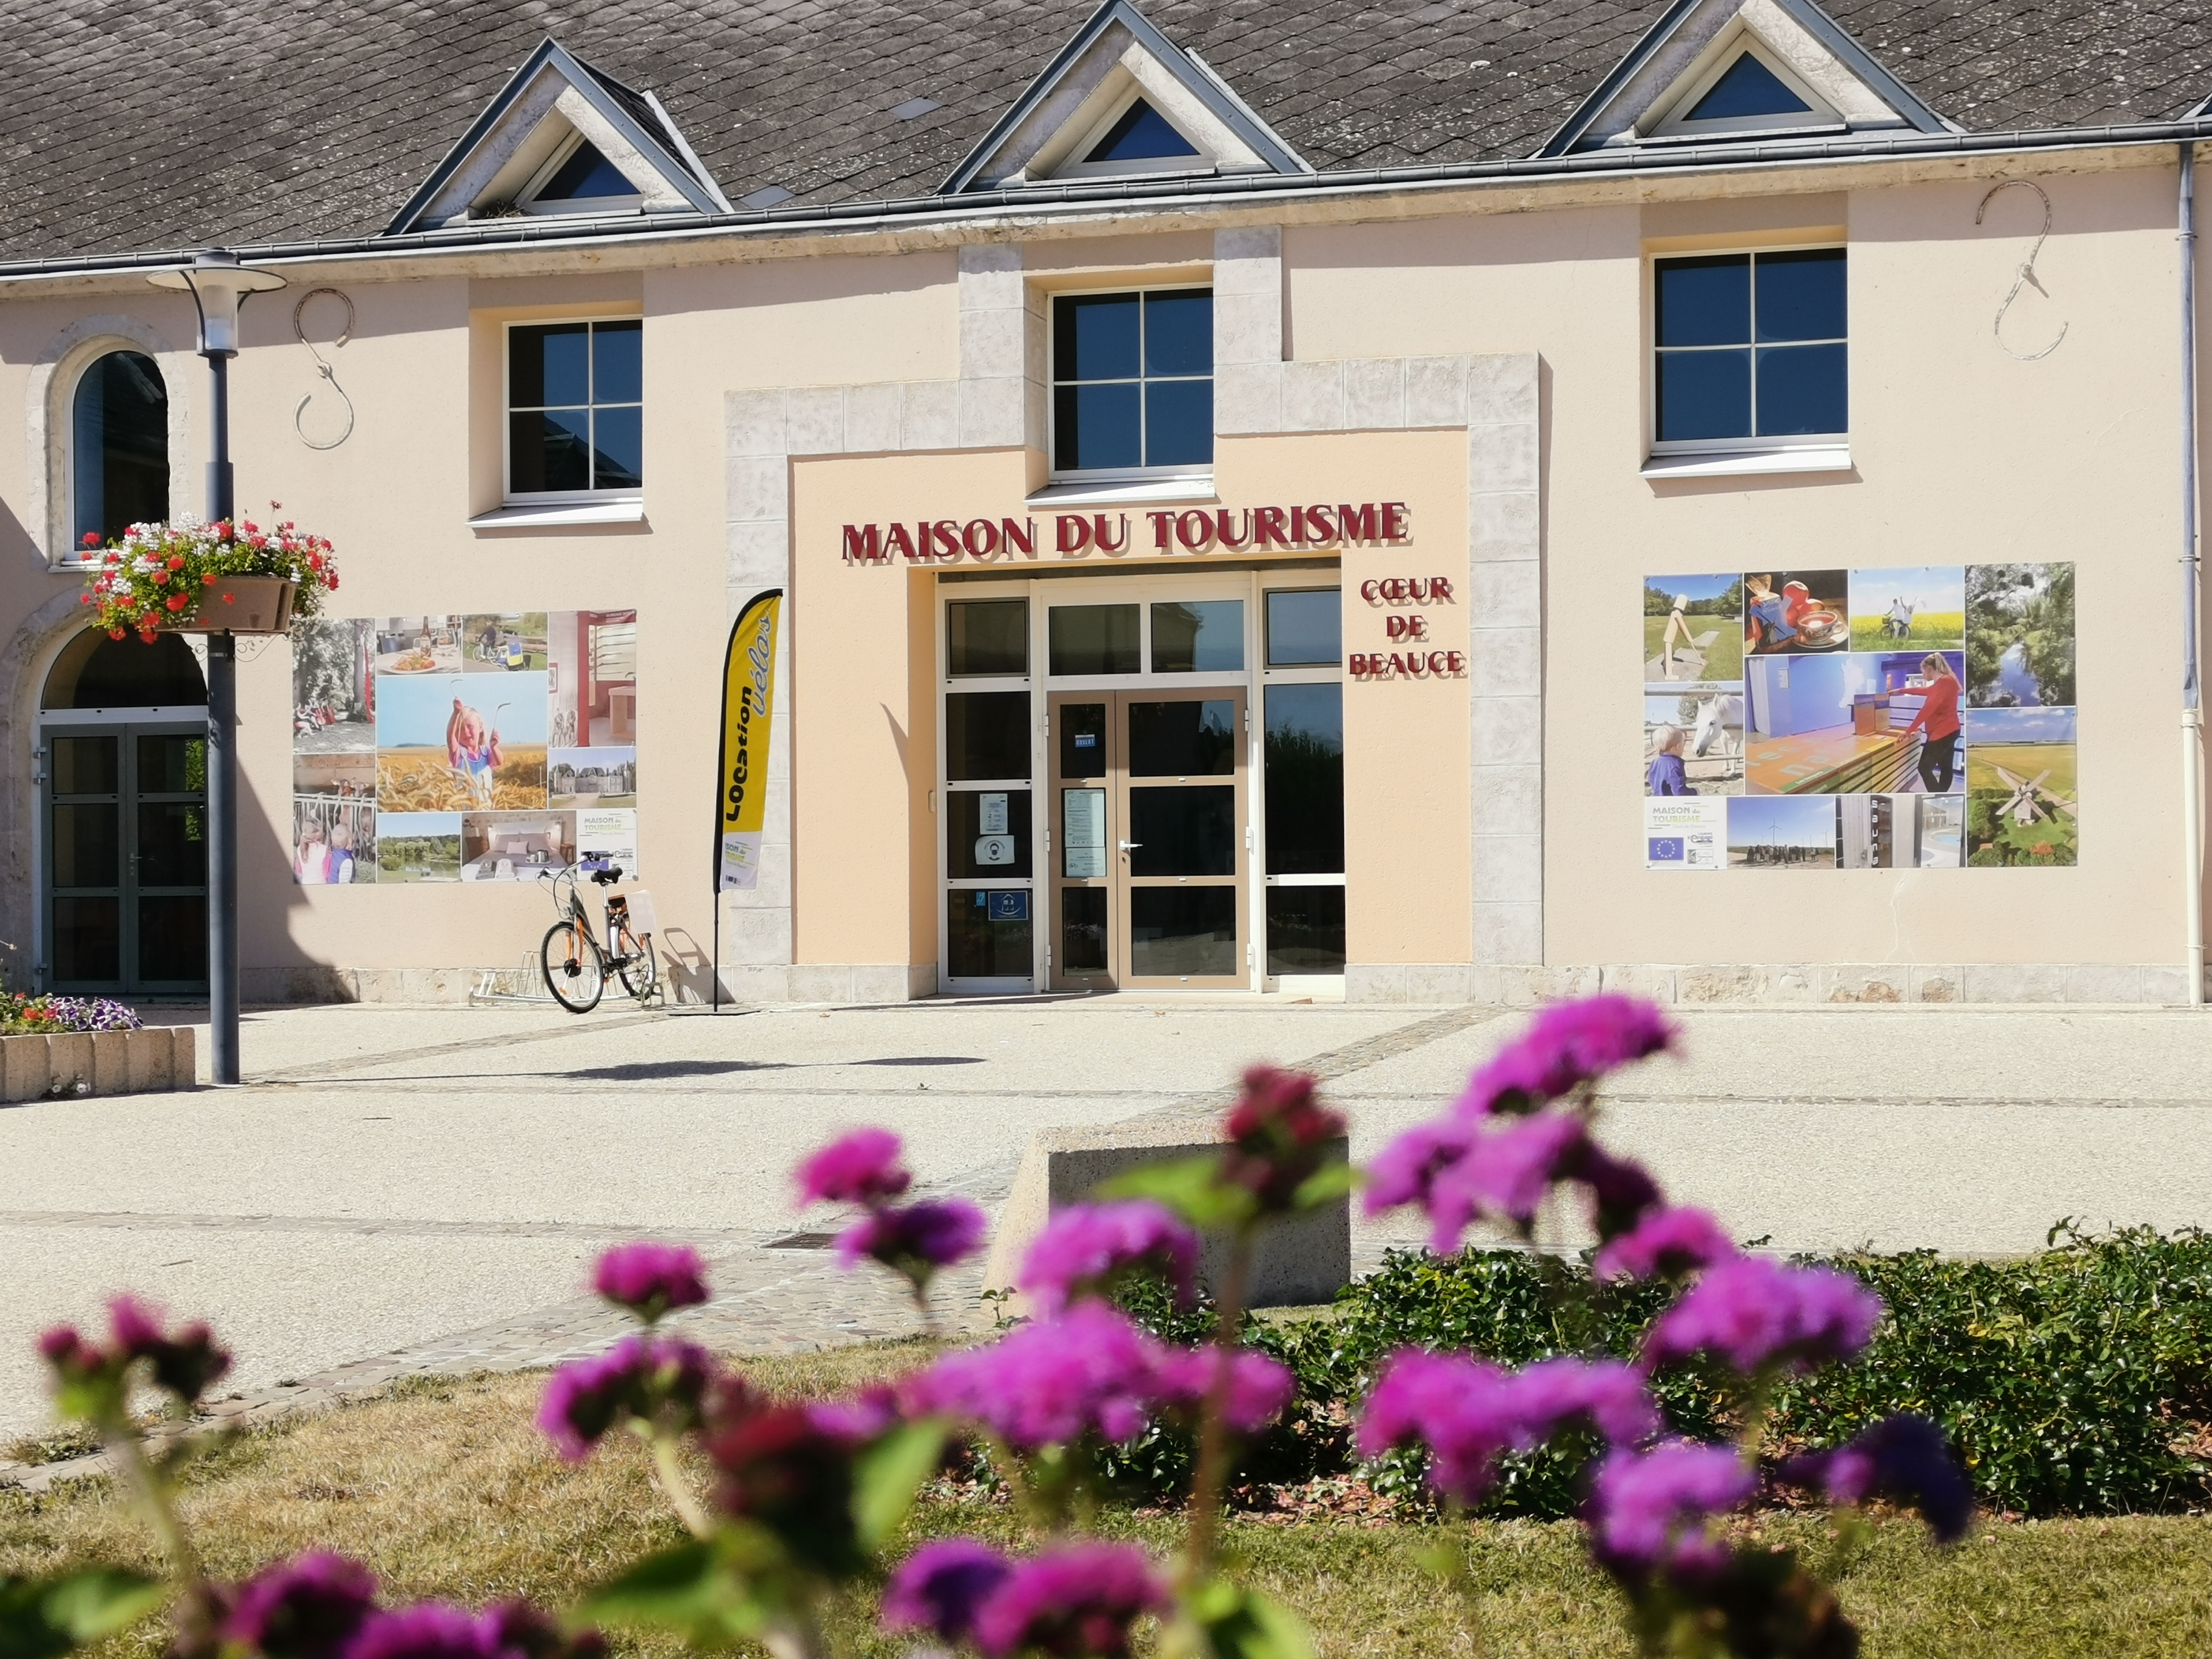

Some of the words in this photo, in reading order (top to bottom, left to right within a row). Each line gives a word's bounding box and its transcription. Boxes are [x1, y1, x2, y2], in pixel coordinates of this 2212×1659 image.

[842, 517, 1032, 560] MAISON
[1056, 513, 1126, 552] DU
[1146, 501, 1409, 548] TOURISME
[1361, 577, 1451, 601] CŒUR
[1386, 615, 1425, 637] DE
[749, 609, 771, 717] vélos
[1349, 651, 1464, 675] BEAUCE
